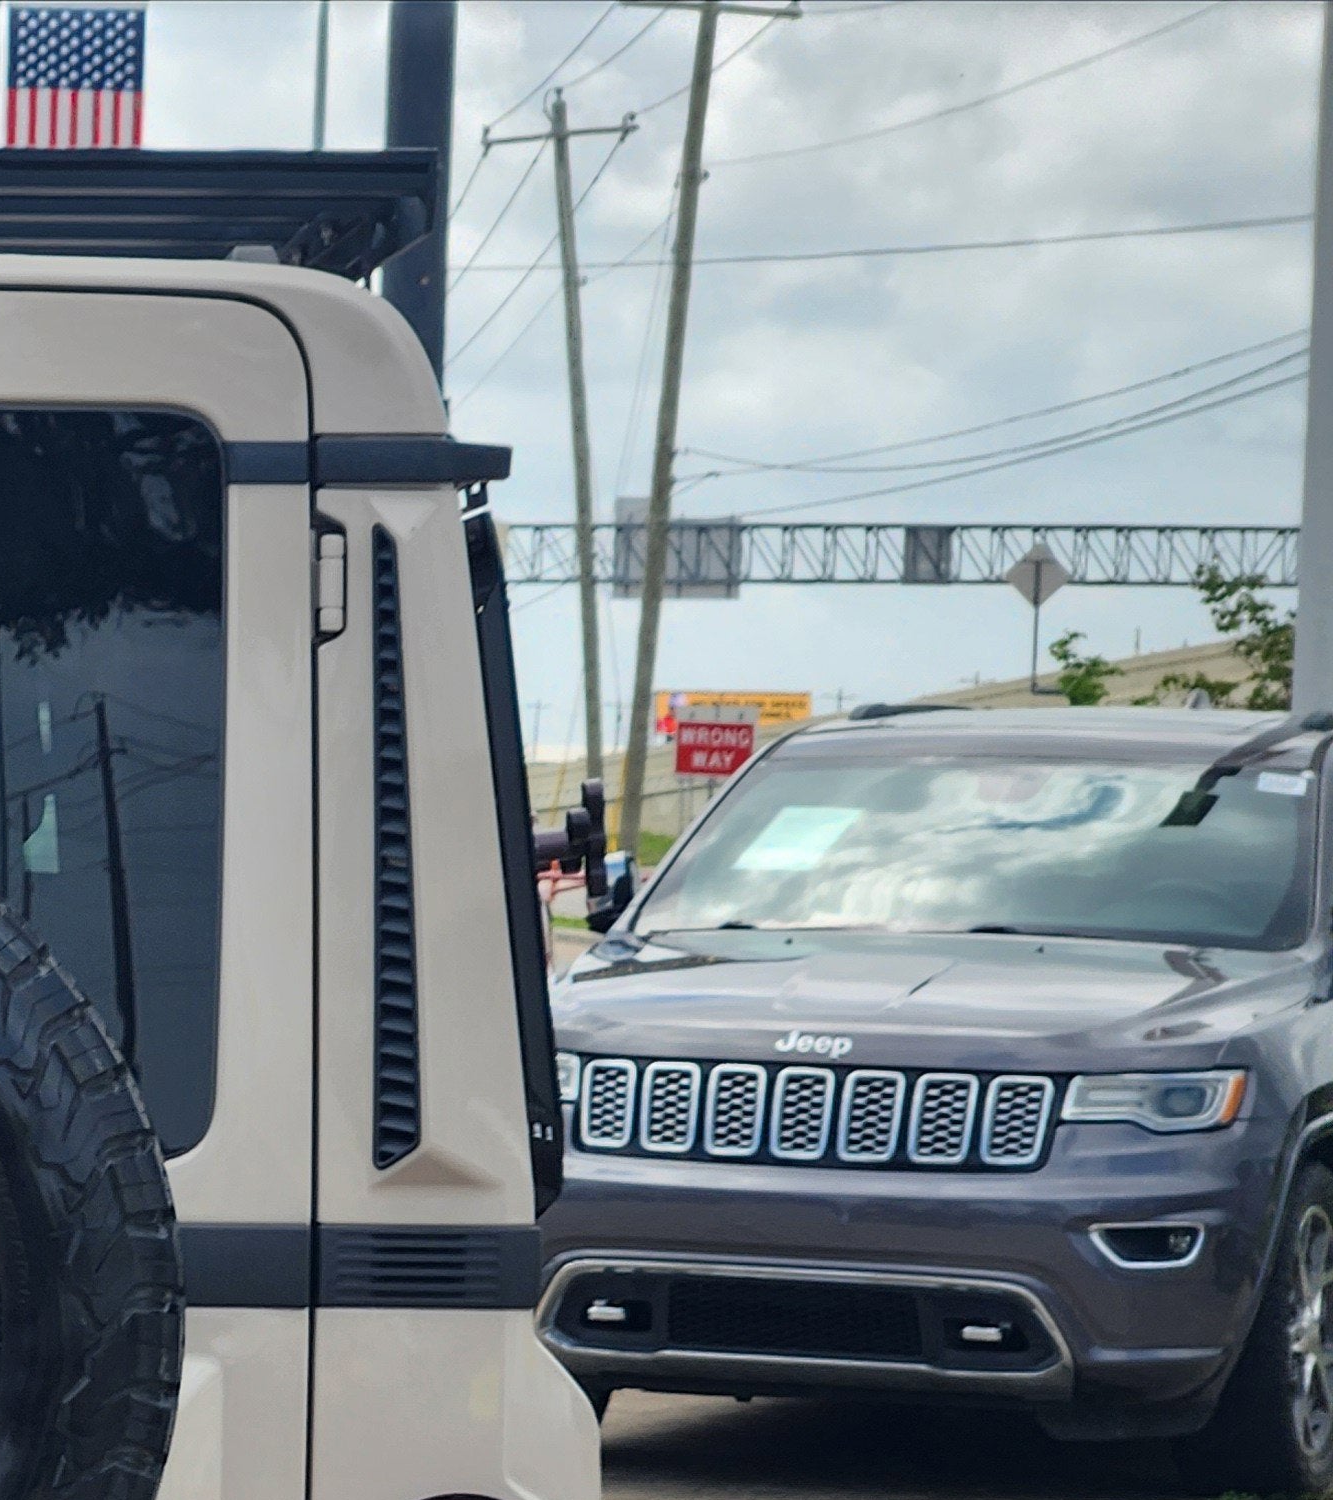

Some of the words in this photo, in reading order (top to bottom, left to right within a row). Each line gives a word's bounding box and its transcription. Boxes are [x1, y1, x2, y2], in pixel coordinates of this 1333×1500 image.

[681, 727, 750, 745] WRONG
[691, 751, 735, 768] WAY
[774, 1029, 853, 1060] Jeep
